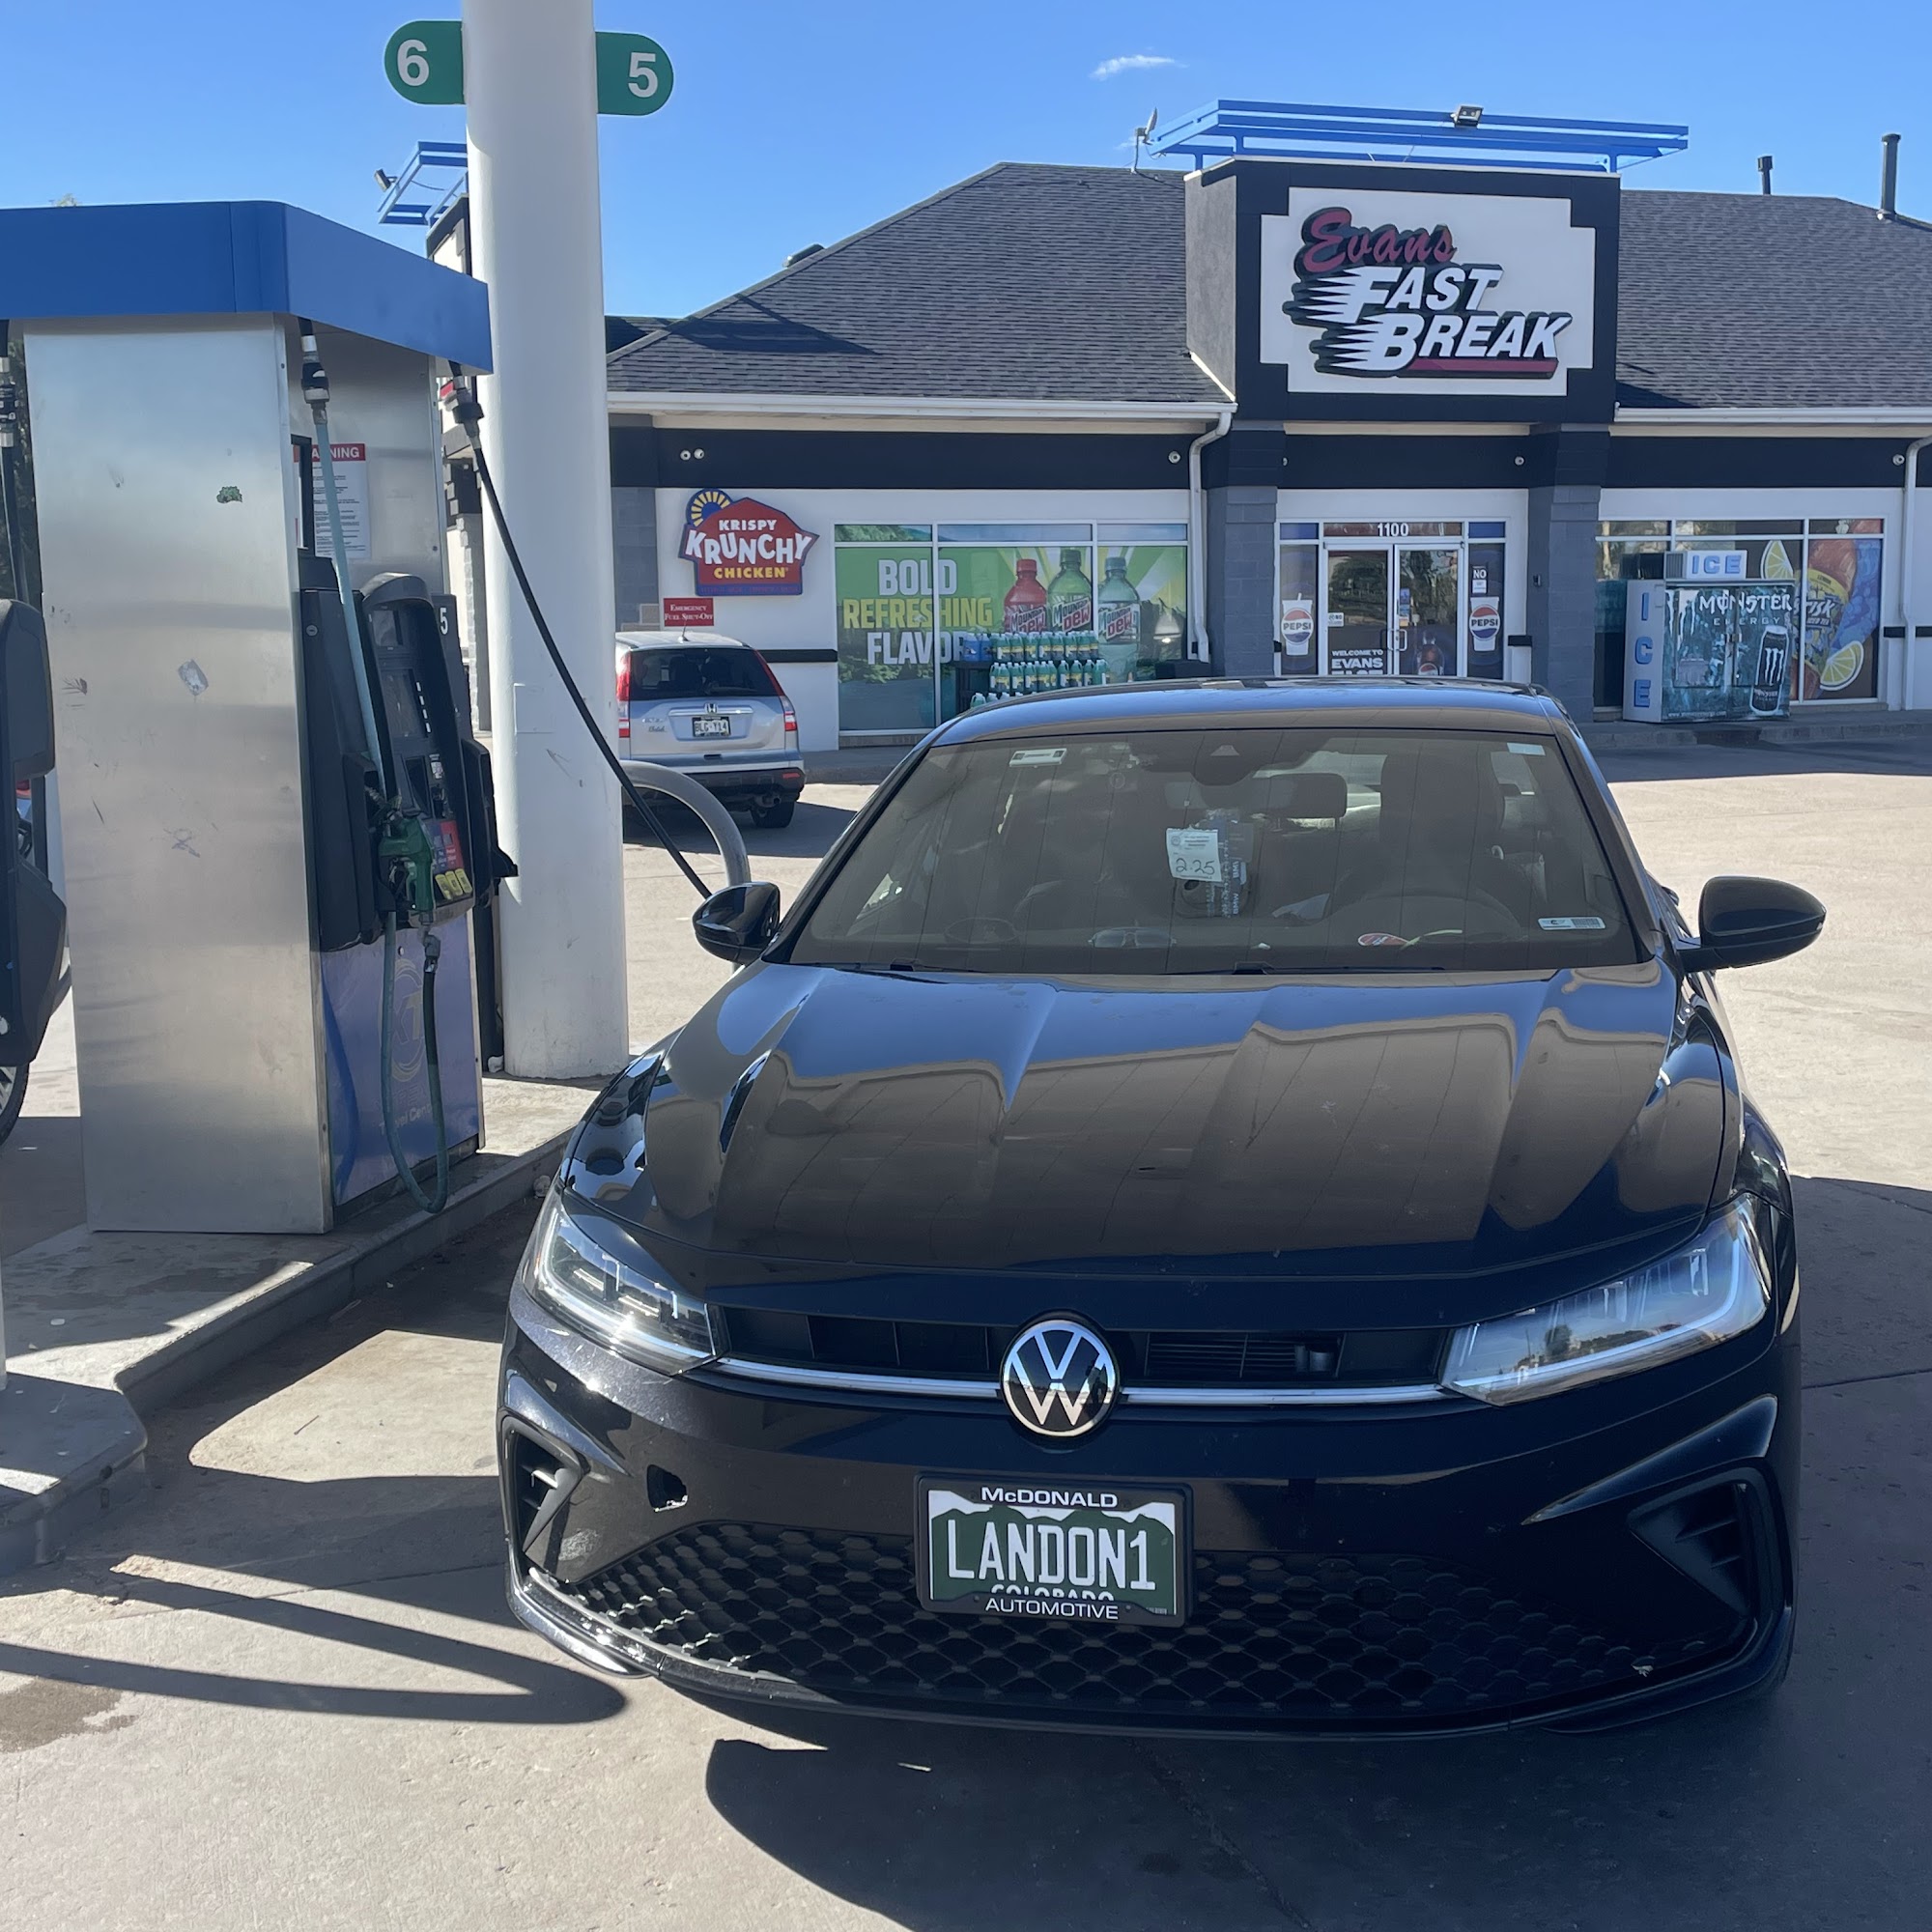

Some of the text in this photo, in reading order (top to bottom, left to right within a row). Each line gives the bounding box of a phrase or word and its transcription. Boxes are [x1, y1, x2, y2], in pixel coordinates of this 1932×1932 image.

[396, 39, 430, 87] 6
[627, 51, 659, 99] 5
[1303, 210, 1457, 273] Evans
[1306, 266, 1504, 324] FAST
[1330, 313, 1572, 371] BREAK
[718, 519, 778, 531] KRISPY
[1378, 523, 1409, 537] 1100
[685, 529, 812, 565] KRUNCHY
[713, 566, 787, 580] CHICKEN
[1473, 569, 1487, 580] NO
[1691, 554, 1742, 575] ICE
[878, 559, 957, 596] BOLD
[669, 604, 707, 612] EMERGENCY
[842, 597, 994, 630] REFRESHING
[440, 607, 448, 635] 5
[1283, 621, 1311, 631] PEPSI
[1471, 618, 1498, 627] PEPSI
[1331, 657, 1384, 669] EVANS
[980, 1487, 1118, 1509] McDONALD
[948, 1519, 1156, 1591] LANDON1
[985, 1597, 1119, 1620] AUTOMOTIVE
